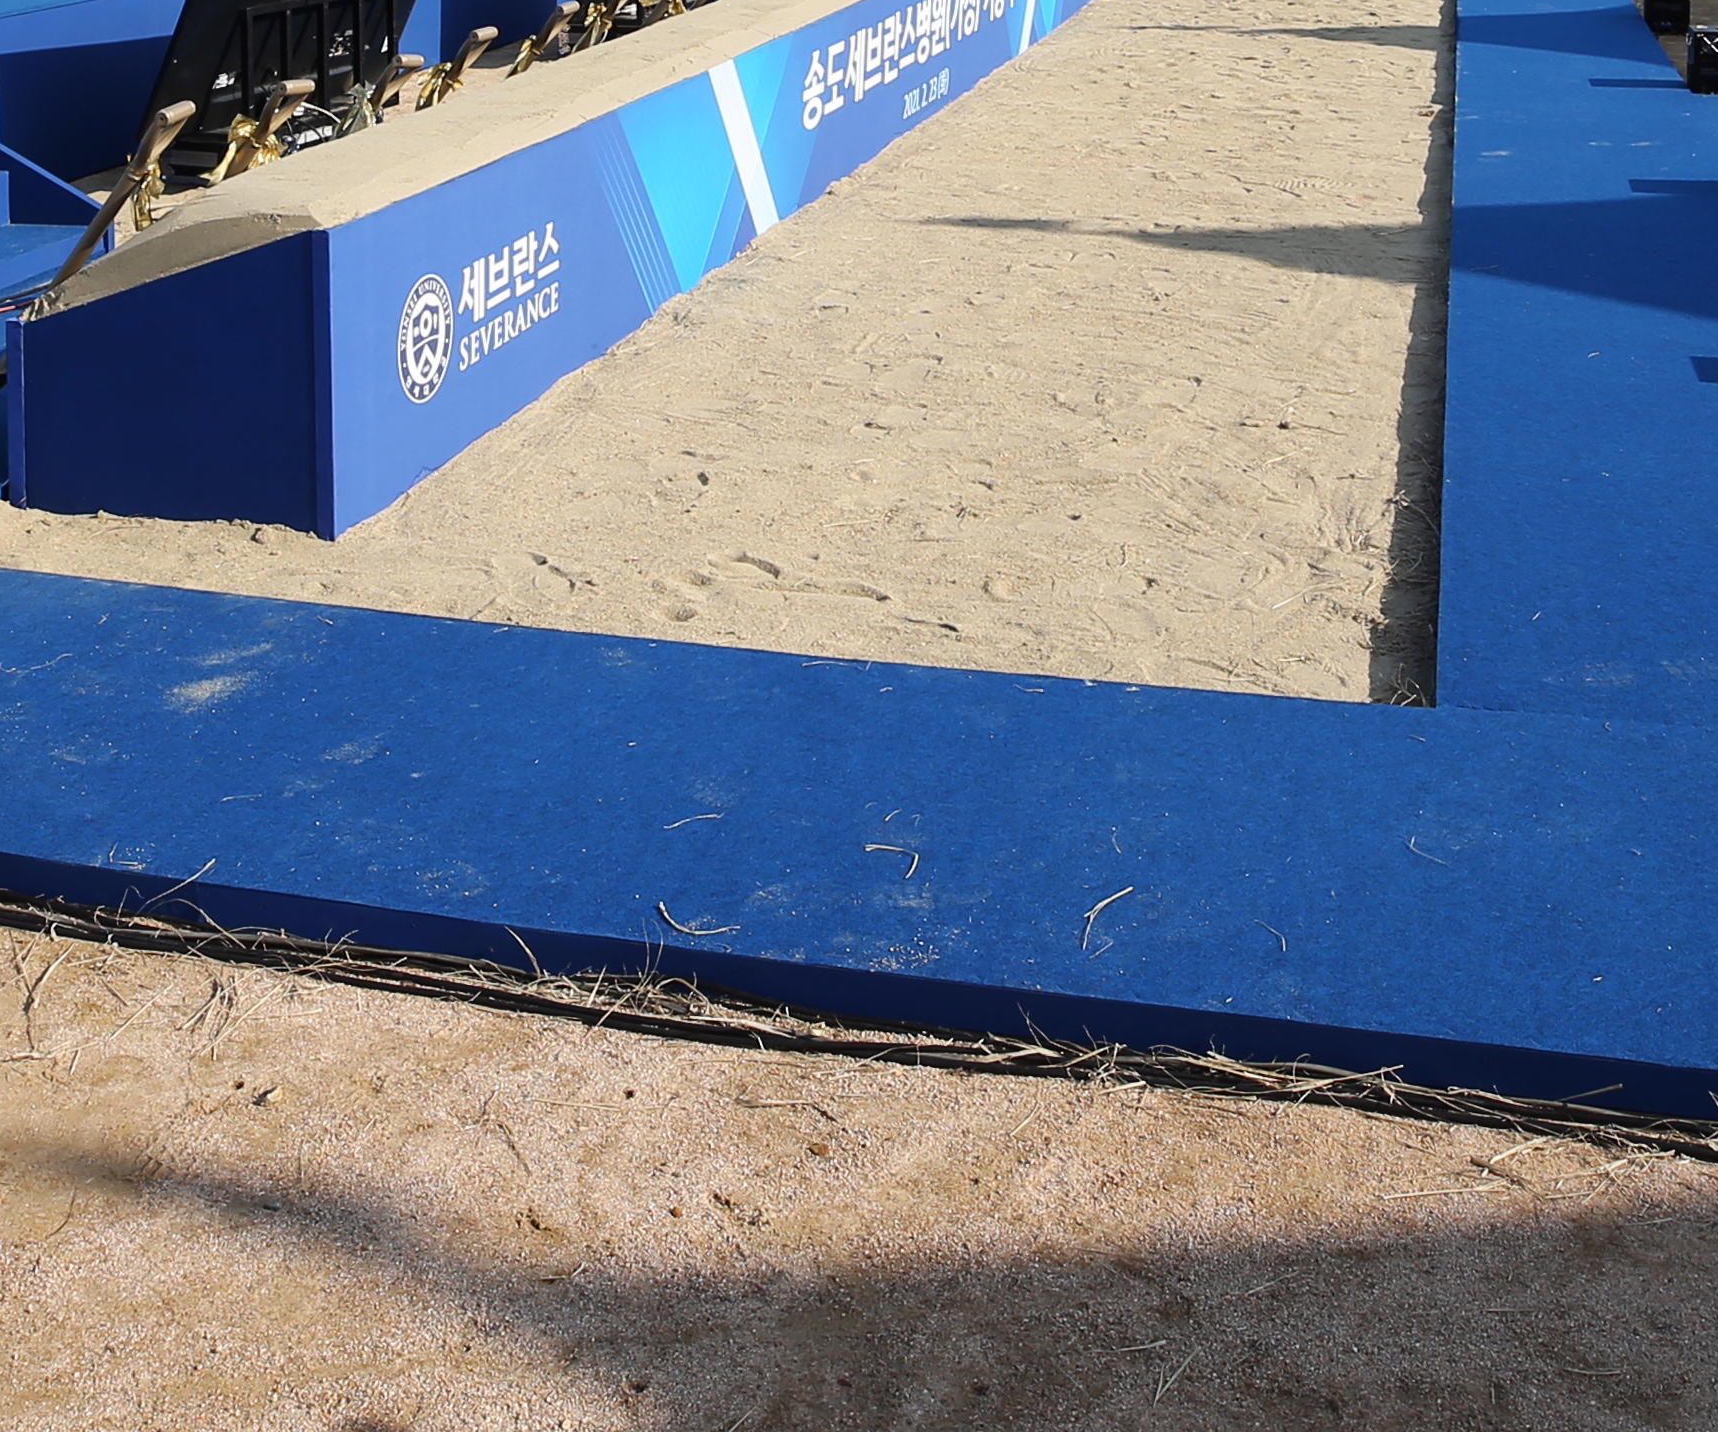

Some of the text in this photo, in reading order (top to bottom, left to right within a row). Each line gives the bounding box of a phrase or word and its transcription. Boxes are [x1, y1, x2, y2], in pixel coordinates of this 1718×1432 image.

[928, 76, 938, 103] 23
[457, 221, 561, 324] 세브란스
[458, 281, 561, 373] SEVERANCE
